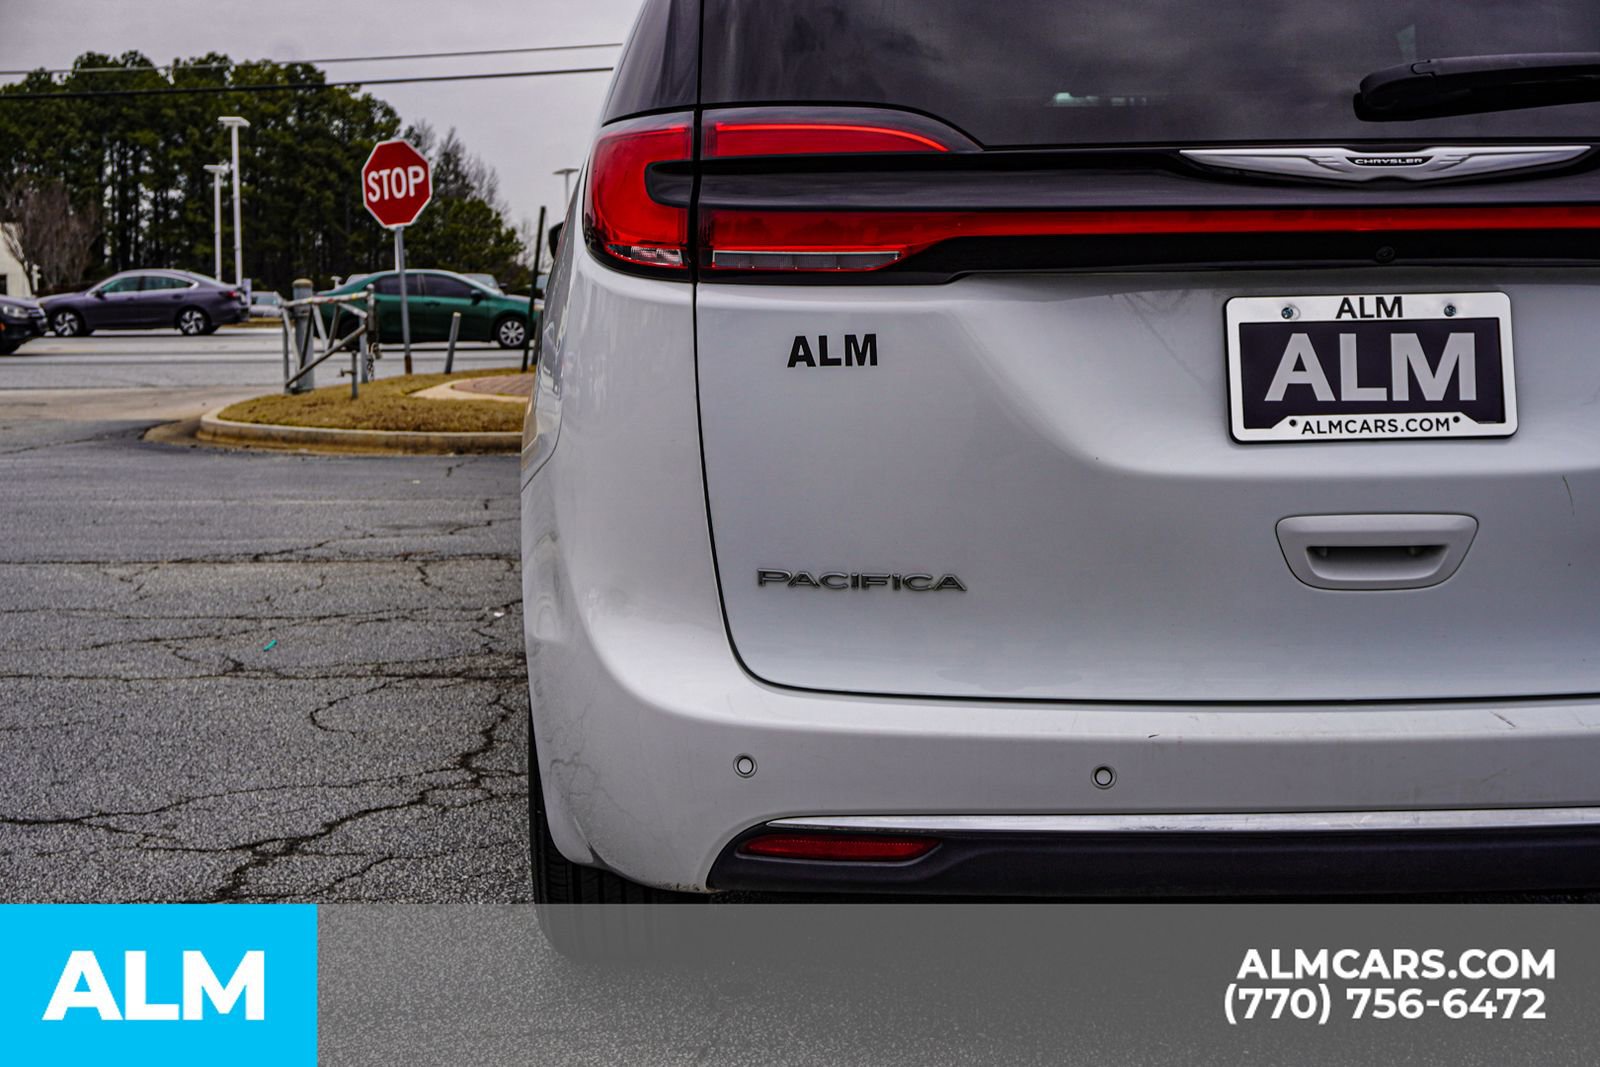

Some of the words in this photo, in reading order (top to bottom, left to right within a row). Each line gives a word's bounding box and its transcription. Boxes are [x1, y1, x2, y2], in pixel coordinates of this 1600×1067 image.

[367, 165, 425, 203] STOP
[1335, 296, 1403, 319] ALM
[787, 334, 878, 368] ALM
[1264, 332, 1477, 402] ALM
[1301, 417, 1450, 435] ALMCARS.COM
[757, 568, 967, 592] PACIFICA
